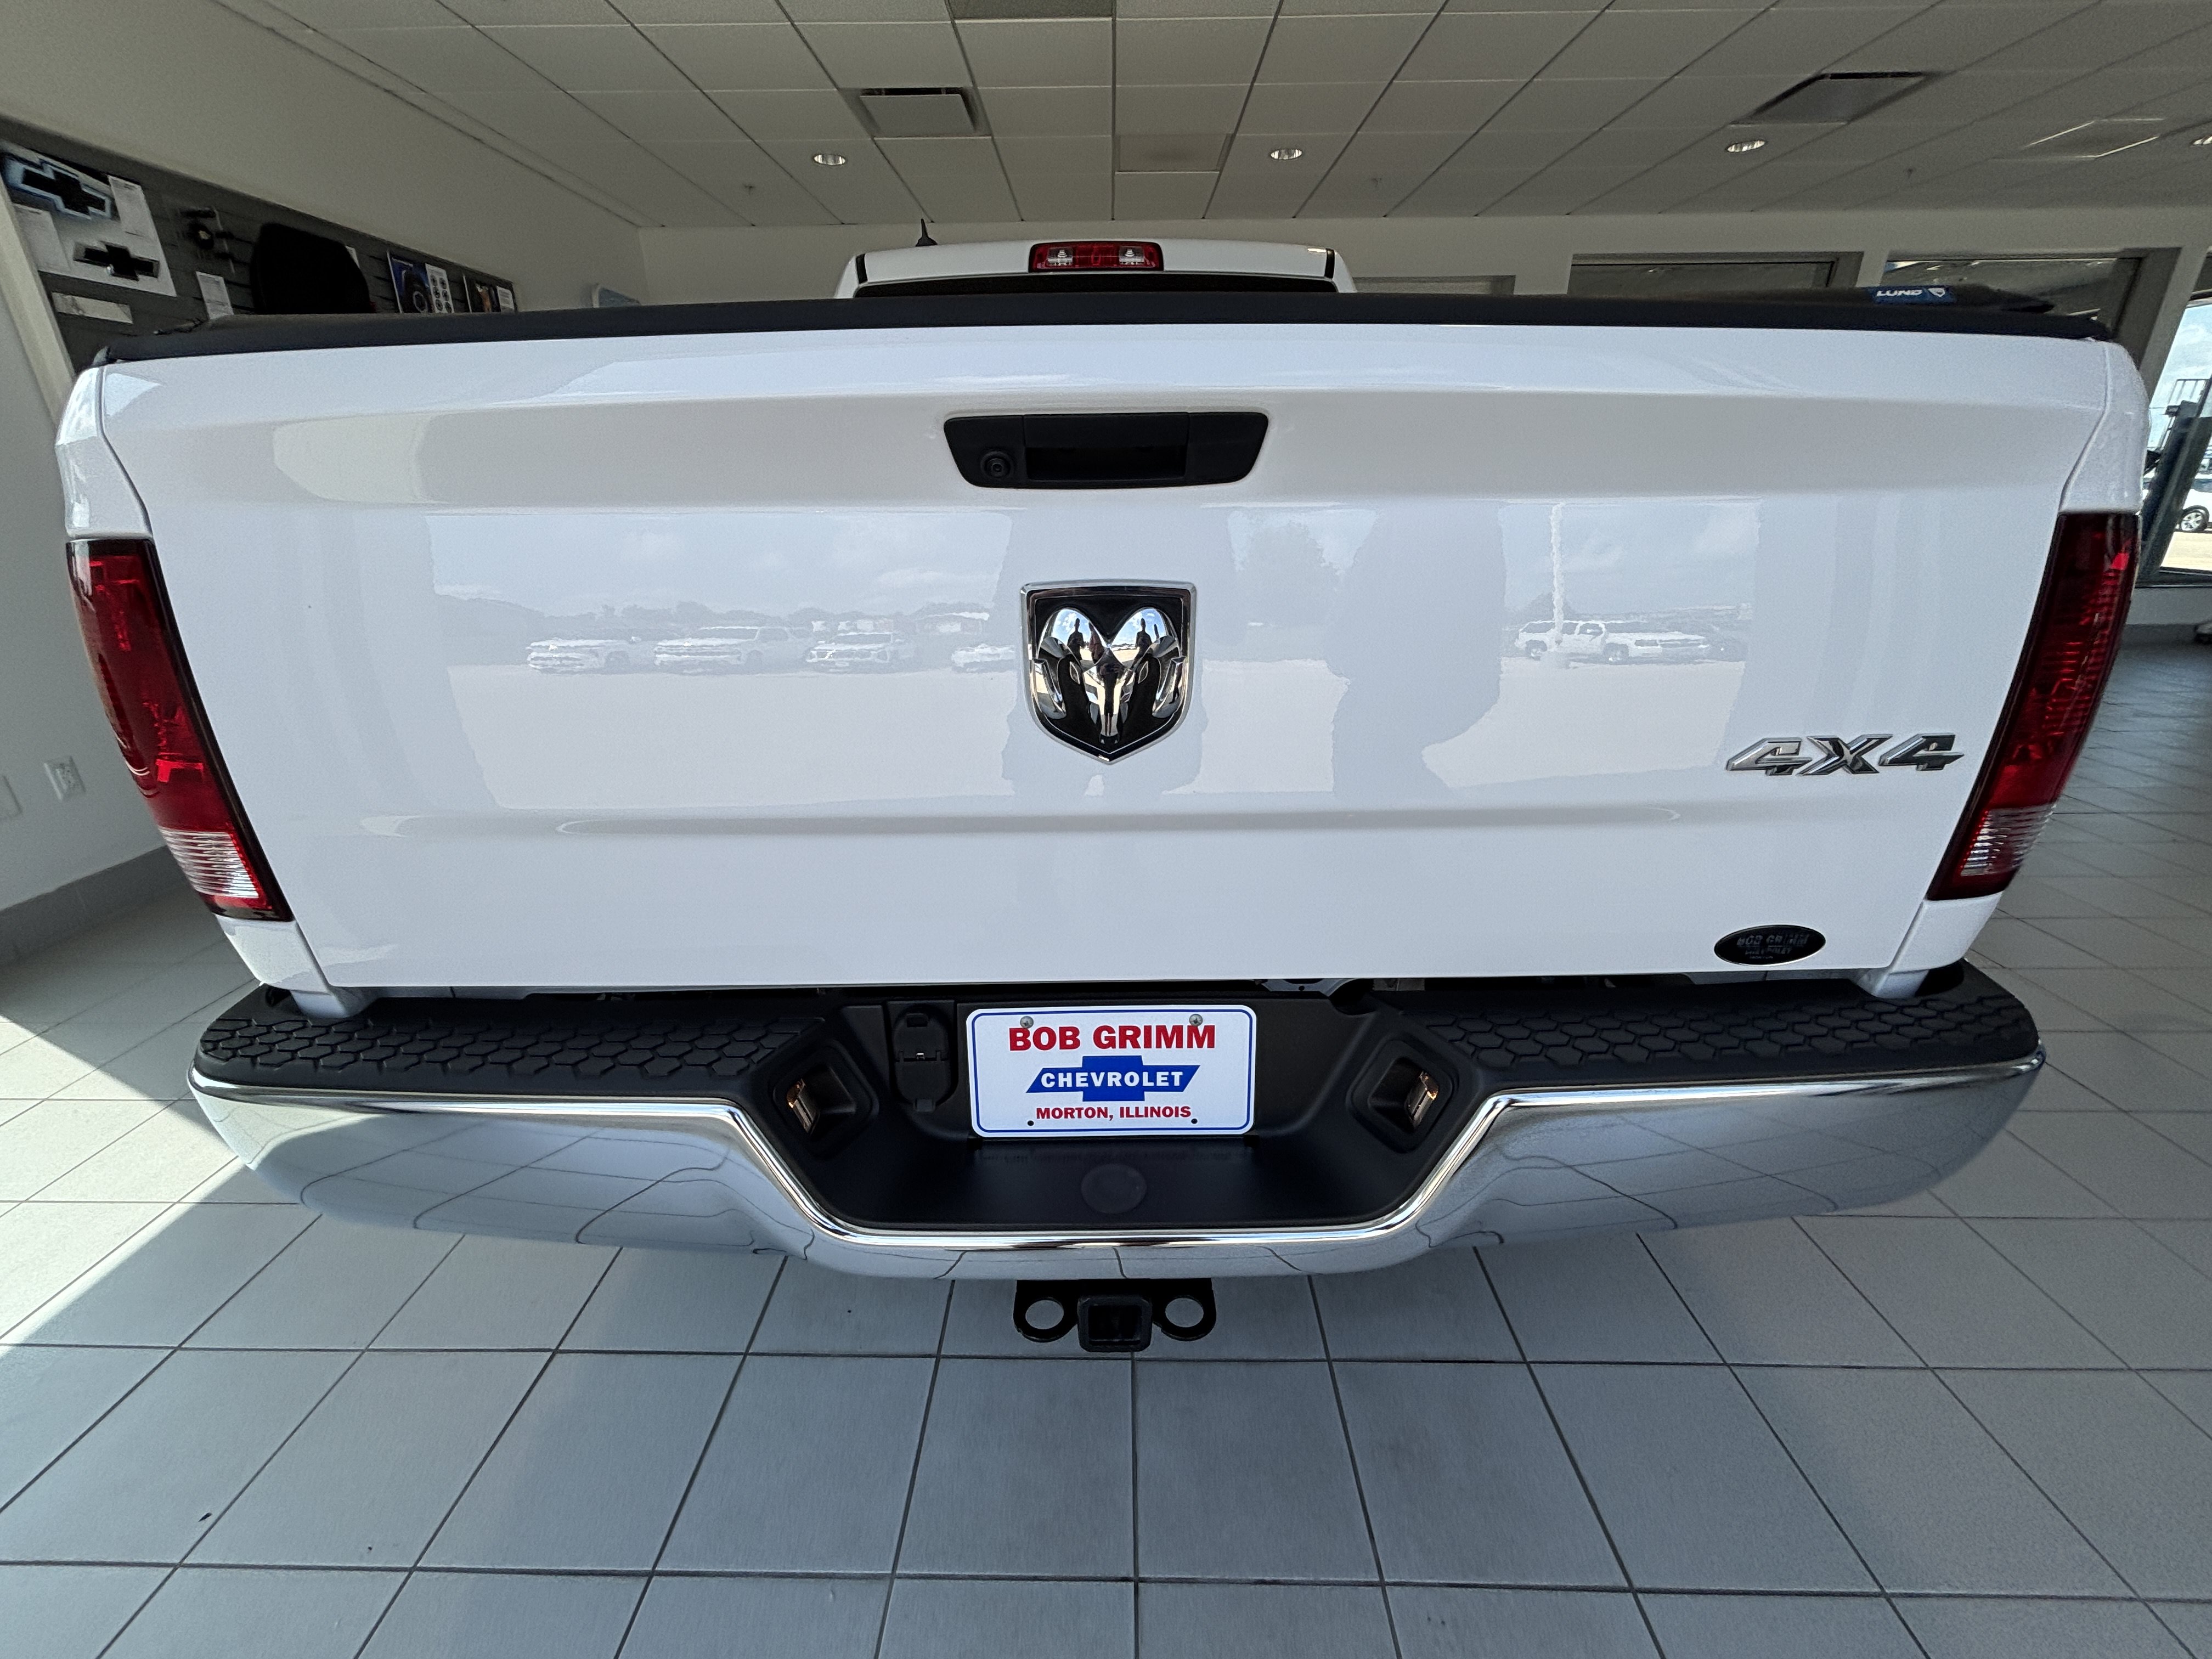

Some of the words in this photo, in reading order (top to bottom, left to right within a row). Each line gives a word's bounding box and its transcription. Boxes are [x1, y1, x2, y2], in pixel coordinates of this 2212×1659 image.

[1009, 1026, 1081, 1051] BOB
[1093, 1024, 1216, 1049] GRIMM
[1041, 1071, 1183, 1088] CHEVROLET
[1036, 1107, 1114, 1121] MORTON,
[1119, 1105, 1192, 1119] ILLINOIS
